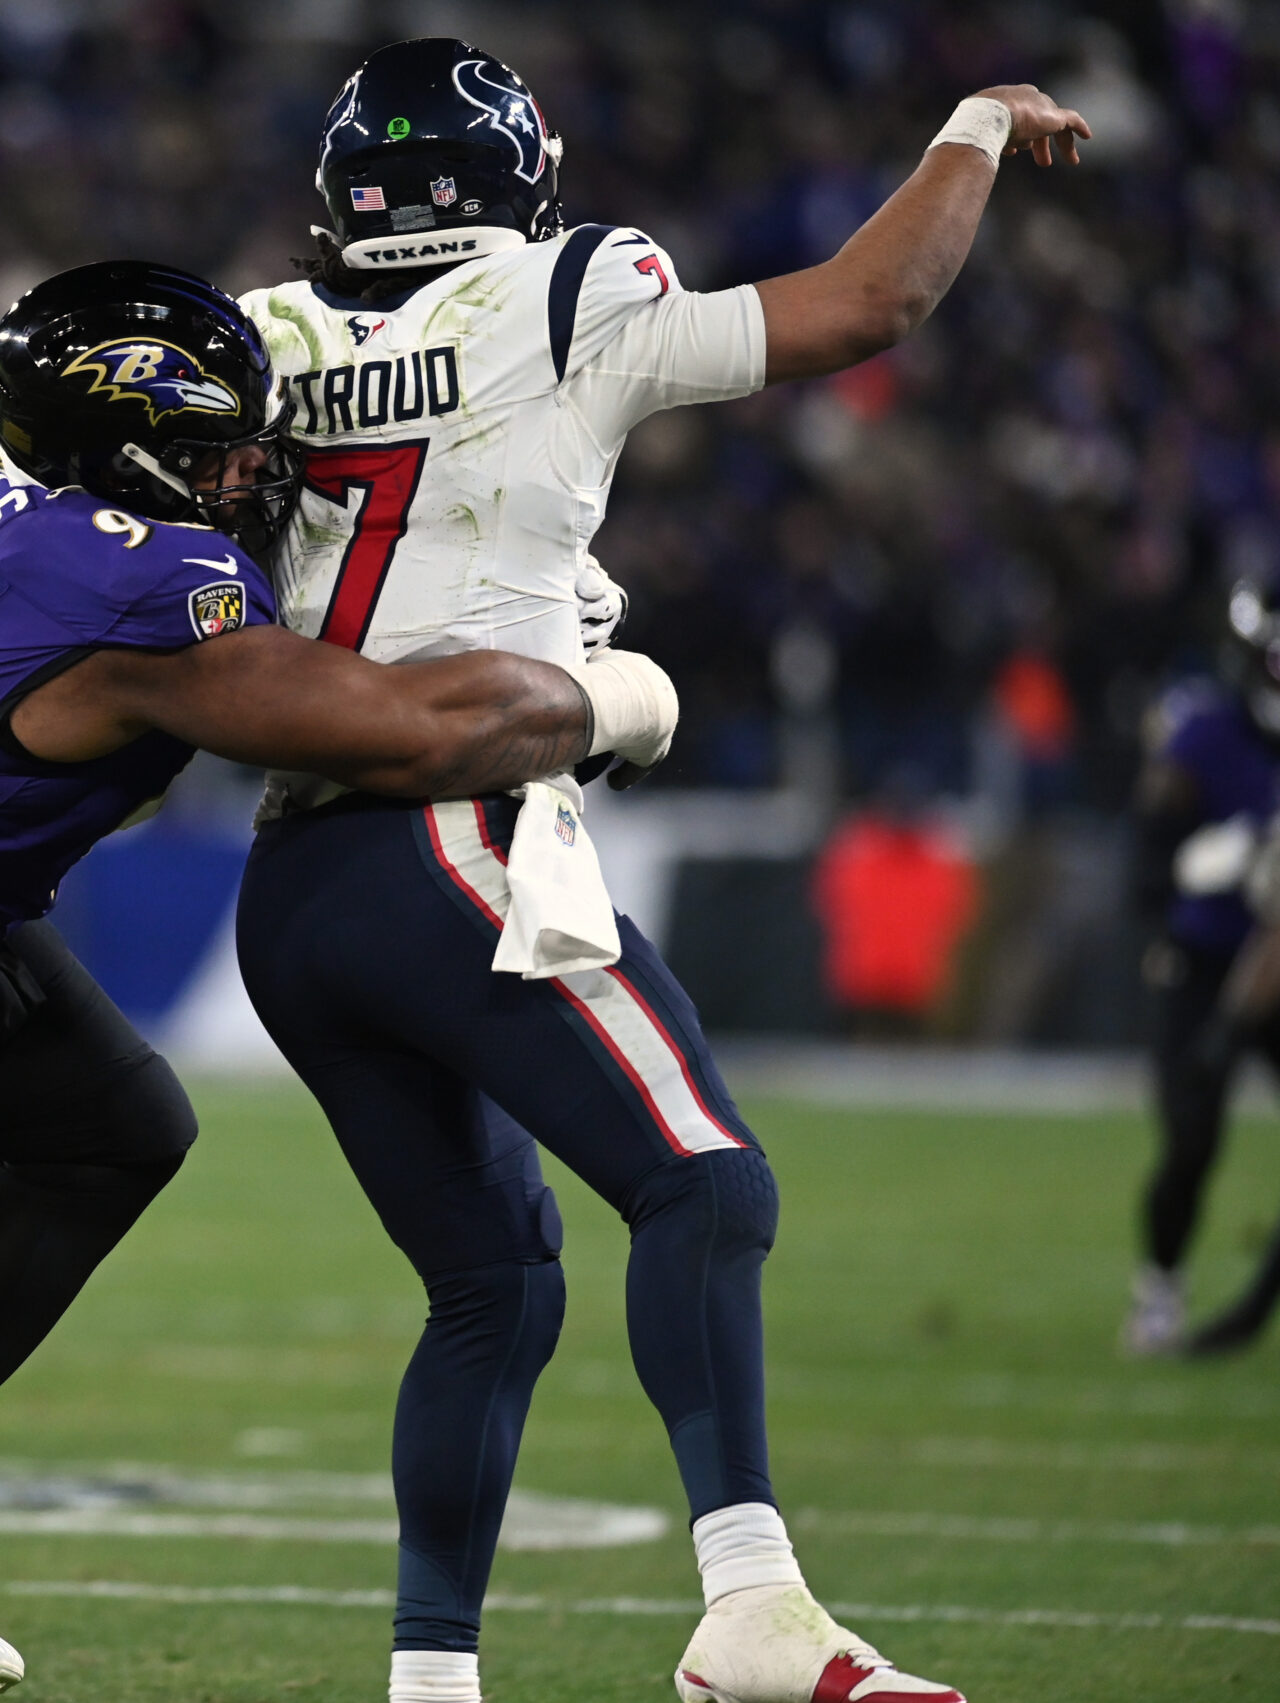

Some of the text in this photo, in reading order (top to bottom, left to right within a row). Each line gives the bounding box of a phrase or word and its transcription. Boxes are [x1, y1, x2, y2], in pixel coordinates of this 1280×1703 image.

[436, 190, 454, 201] NFL
[363, 240, 477, 263] TEXANS
[632, 253, 669, 297] 7
[103, 345, 164, 383] B
[282, 346, 460, 434] TROUD
[300, 437, 430, 654] 7
[197, 588, 238, 601] RAVENS
[556, 818, 574, 844] NFL
